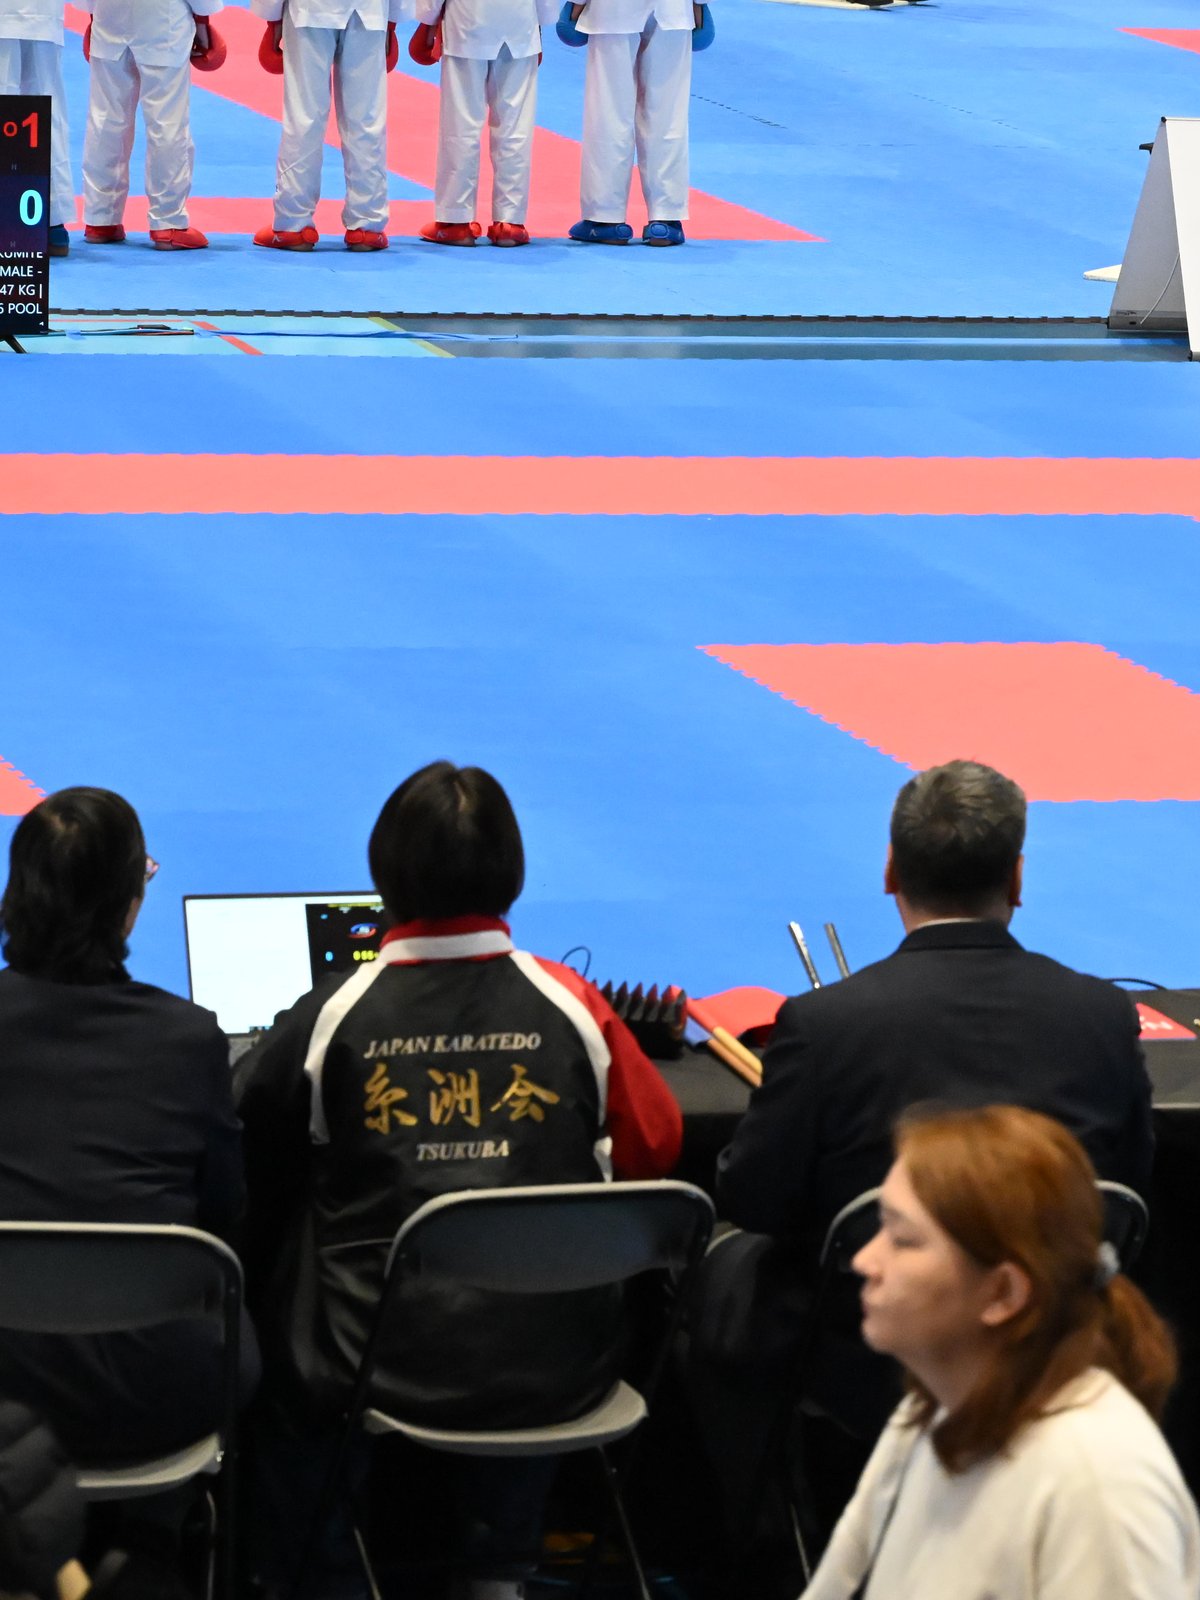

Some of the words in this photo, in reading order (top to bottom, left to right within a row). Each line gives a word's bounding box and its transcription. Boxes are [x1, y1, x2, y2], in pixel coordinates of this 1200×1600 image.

[22, 112, 38, 148] 1
[20, 190, 43, 226] 0
[18, 284, 36, 296] KG
[8, 302, 43, 314] POOL
[363, 1036, 431, 1060] JAPAN
[433, 1032, 542, 1054] KARATEDO
[415, 1139, 510, 1161] TSUKUBA
